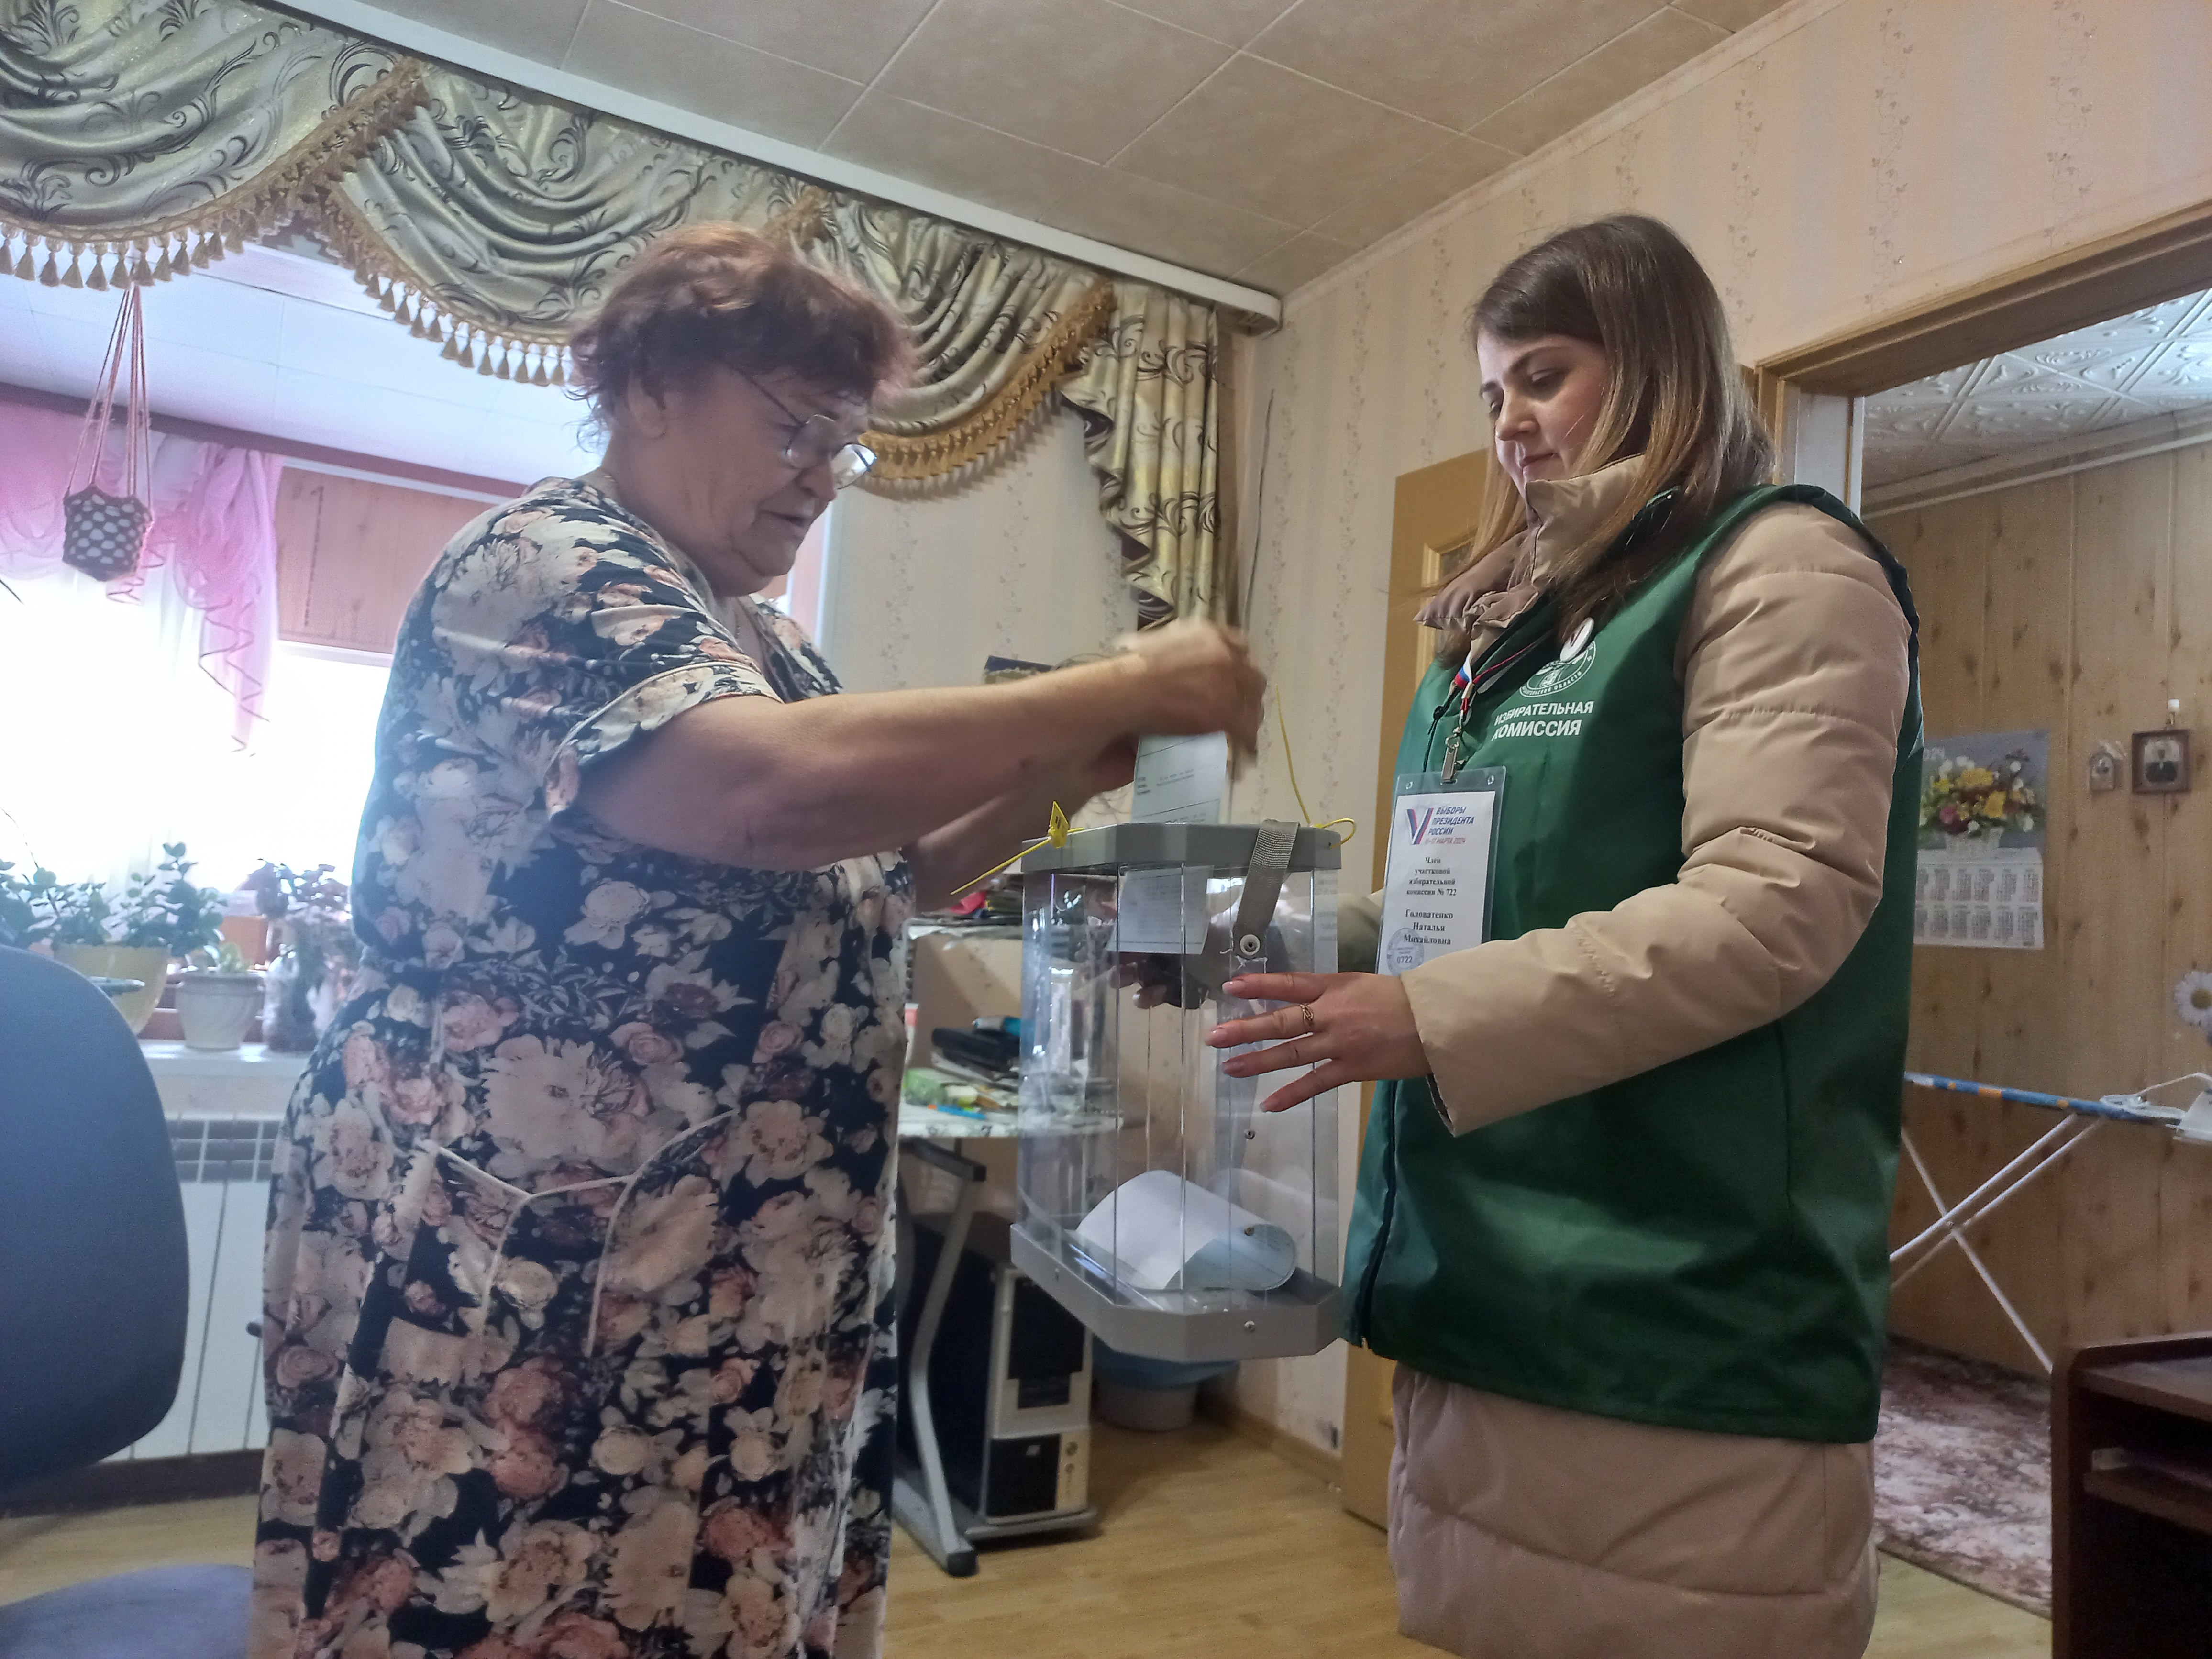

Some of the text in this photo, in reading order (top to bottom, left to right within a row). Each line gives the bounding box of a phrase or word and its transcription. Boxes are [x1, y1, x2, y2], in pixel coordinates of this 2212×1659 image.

[1494, 701, 1595, 726] ИЗБИРАТЕЛЬНАЯ
[1491, 719, 1582, 741] КОМИССИЯ
[1436, 806, 1467, 815] ВЫБОРЫ
[1432, 816, 1475, 826] ПРЕЗИДЕНТА
[1409, 877, 1455, 886] избирательной
[1405, 909, 1453, 919] Головатенко
[1413, 922, 1445, 931] Наталья
[1404, 934, 1451, 945] Михайловна
[1397, 956, 1413, 964] 0722
